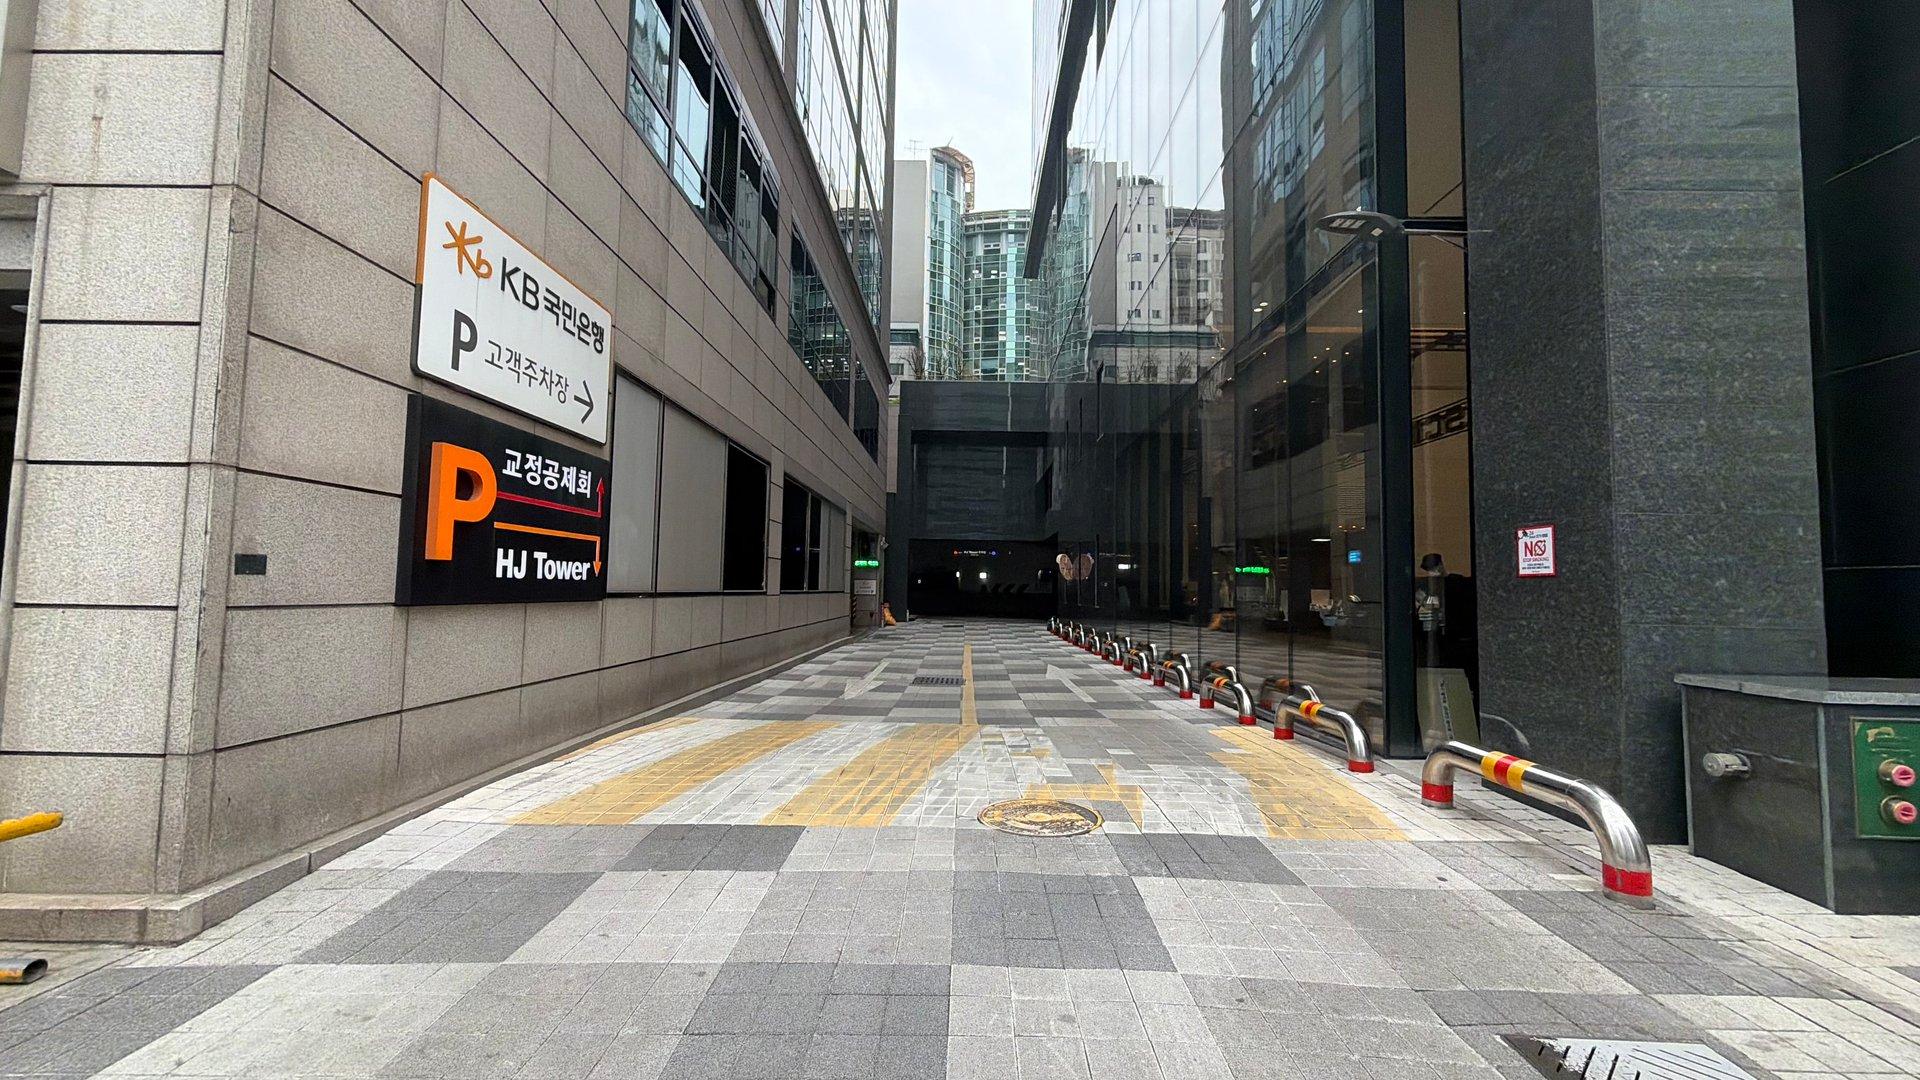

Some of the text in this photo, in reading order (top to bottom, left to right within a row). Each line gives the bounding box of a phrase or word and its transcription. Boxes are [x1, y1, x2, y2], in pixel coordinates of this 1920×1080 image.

[451, 308, 478, 371] P
[485, 340, 569, 404] 고객주차장
[424, 441, 498, 561] P
[502, 448, 592, 498] 교정공제회
[495, 548, 591, 581] HJ Tower
